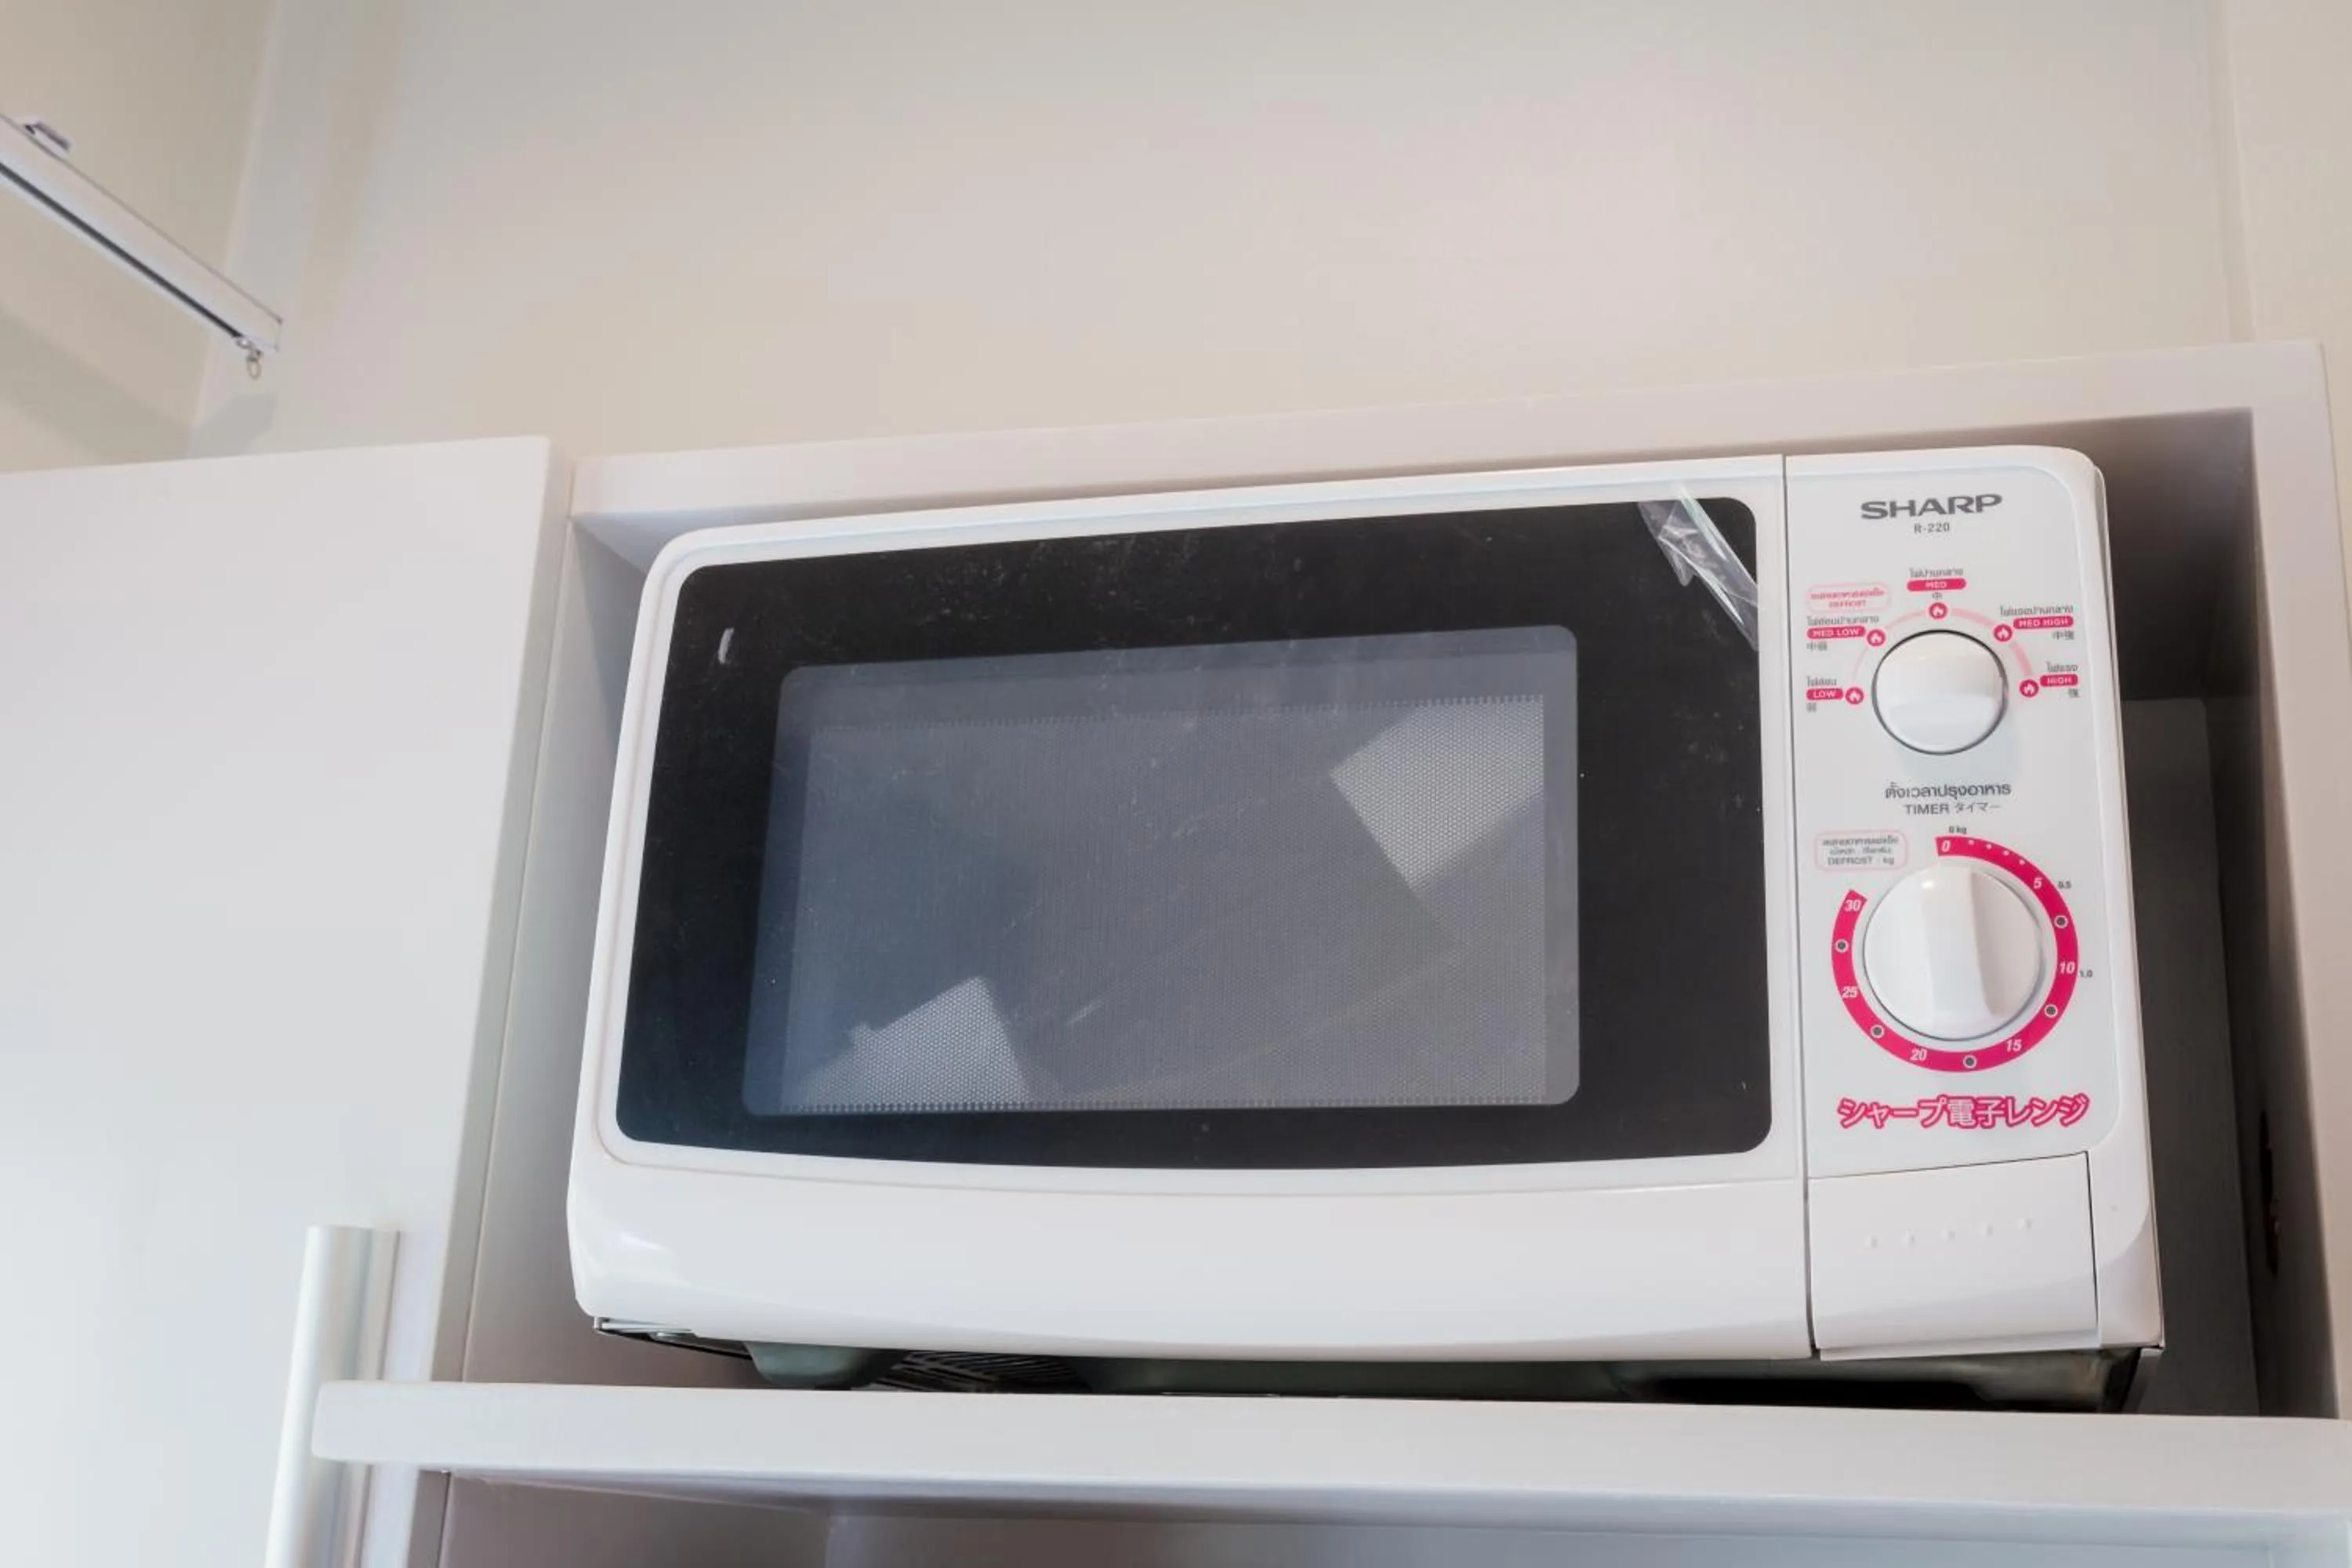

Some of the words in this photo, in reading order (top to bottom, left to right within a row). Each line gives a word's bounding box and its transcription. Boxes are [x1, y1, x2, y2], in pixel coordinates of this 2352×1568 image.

[1860, 493, 2003, 520] SHARP
[1914, 522, 1950, 534] R-220
[1925, 580, 1947, 589] MED
[2019, 619, 2040, 628] MED
[2043, 618, 2068, 626] HIGH
[1837, 628, 1859, 637] LOW
[2047, 676, 2072, 685] HIGH
[1813, 690, 1836, 699] LOW
[1886, 782, 2012, 800] ตั้งเวลาปรุงอาหาร
[1906, 803, 1950, 815] TIMER
[1955, 801, 2002, 813] タイマー
[1941, 840, 1951, 853] 0
[2034, 877, 2042, 889] 5
[1845, 899, 1861, 913] 30
[2060, 960, 2075, 975] 10
[1842, 985, 1858, 998] 25
[2006, 1039, 2022, 1052] 15
[1910, 1048, 1927, 1062] 20
[1837, 1093, 2090, 1128] シャープ電子レンジ
